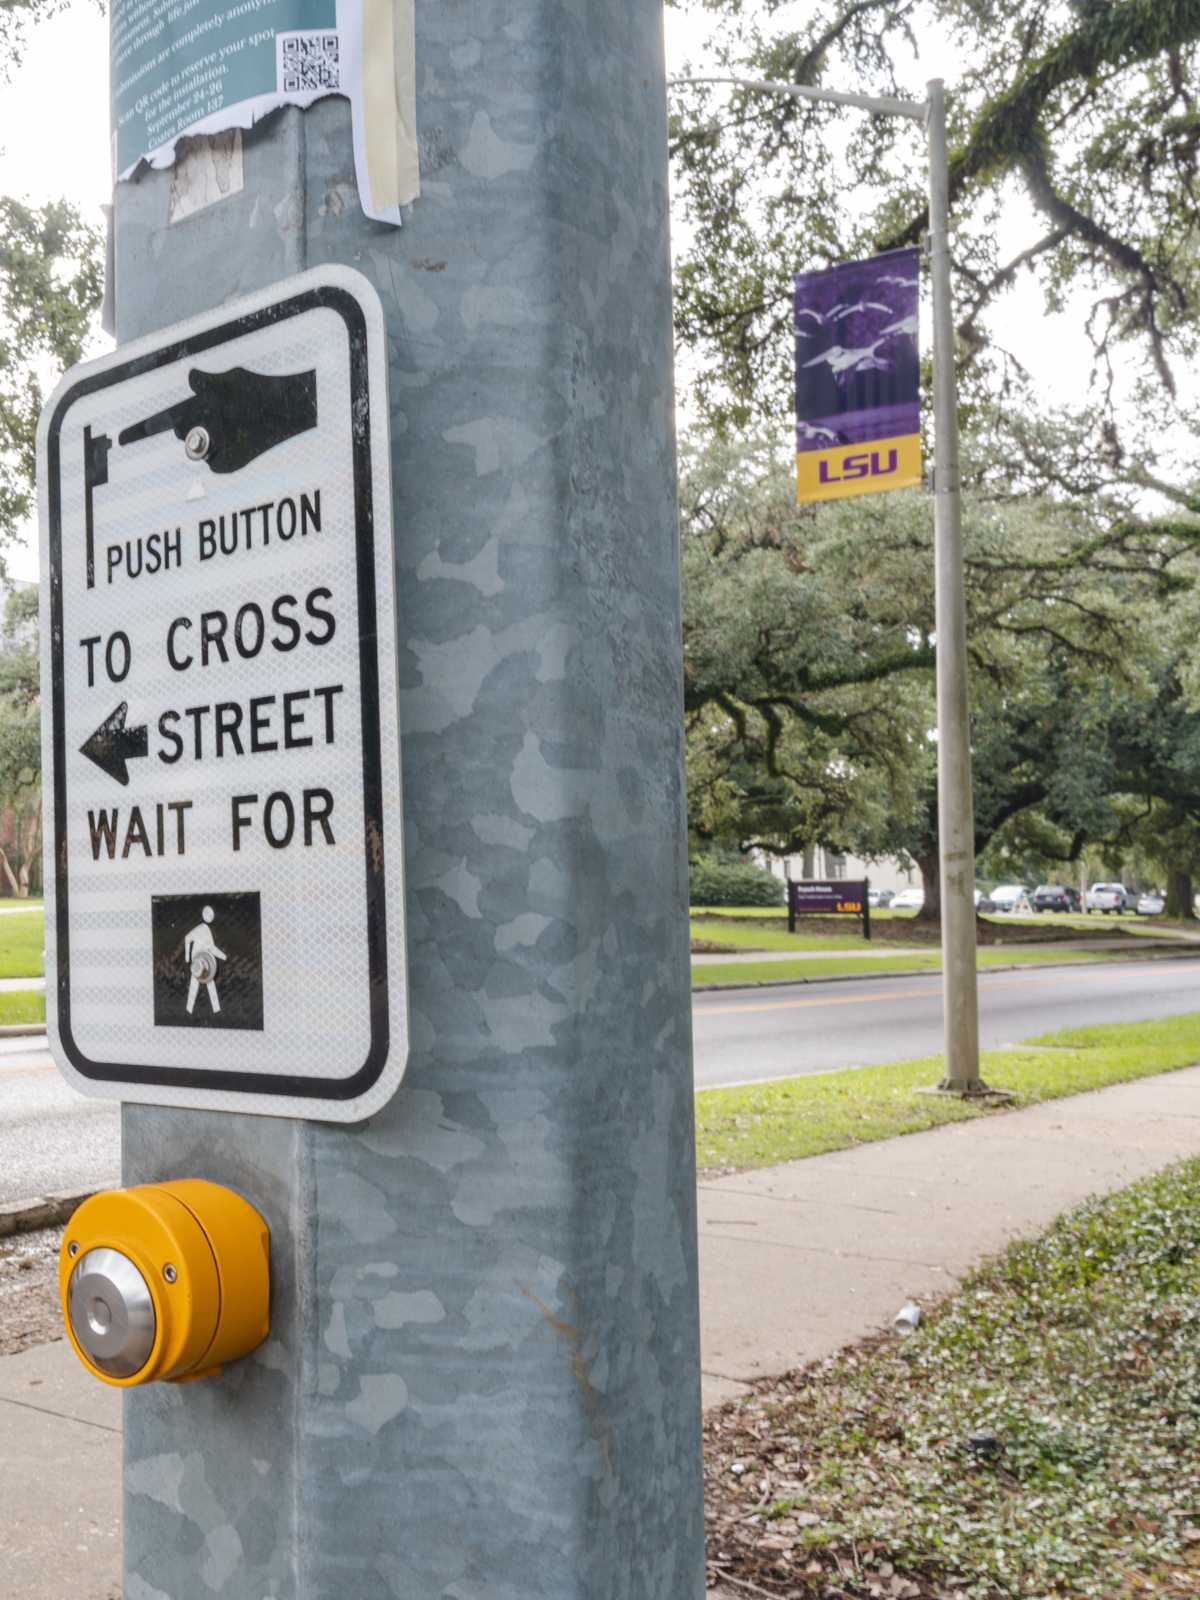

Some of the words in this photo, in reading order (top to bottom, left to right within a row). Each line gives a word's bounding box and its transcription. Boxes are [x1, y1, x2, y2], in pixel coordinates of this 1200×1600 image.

[171, 13, 225, 52] completely
[134, 95, 149, 115] QR
[149, 81, 170, 103] code
[180, 52, 218, 80] reserve
[218, 37, 247, 62] your
[157, 94, 173, 114] the
[146, 96, 191, 137] September
[818, 448, 898, 485] LSU
[106, 527, 183, 584] PUSH
[199, 489, 322, 561] BUTTON
[79, 630, 132, 688] TO
[166, 587, 336, 672] CROSS
[157, 684, 344, 764] STREET
[87, 800, 193, 861] WAIT
[231, 788, 336, 851] FOR
